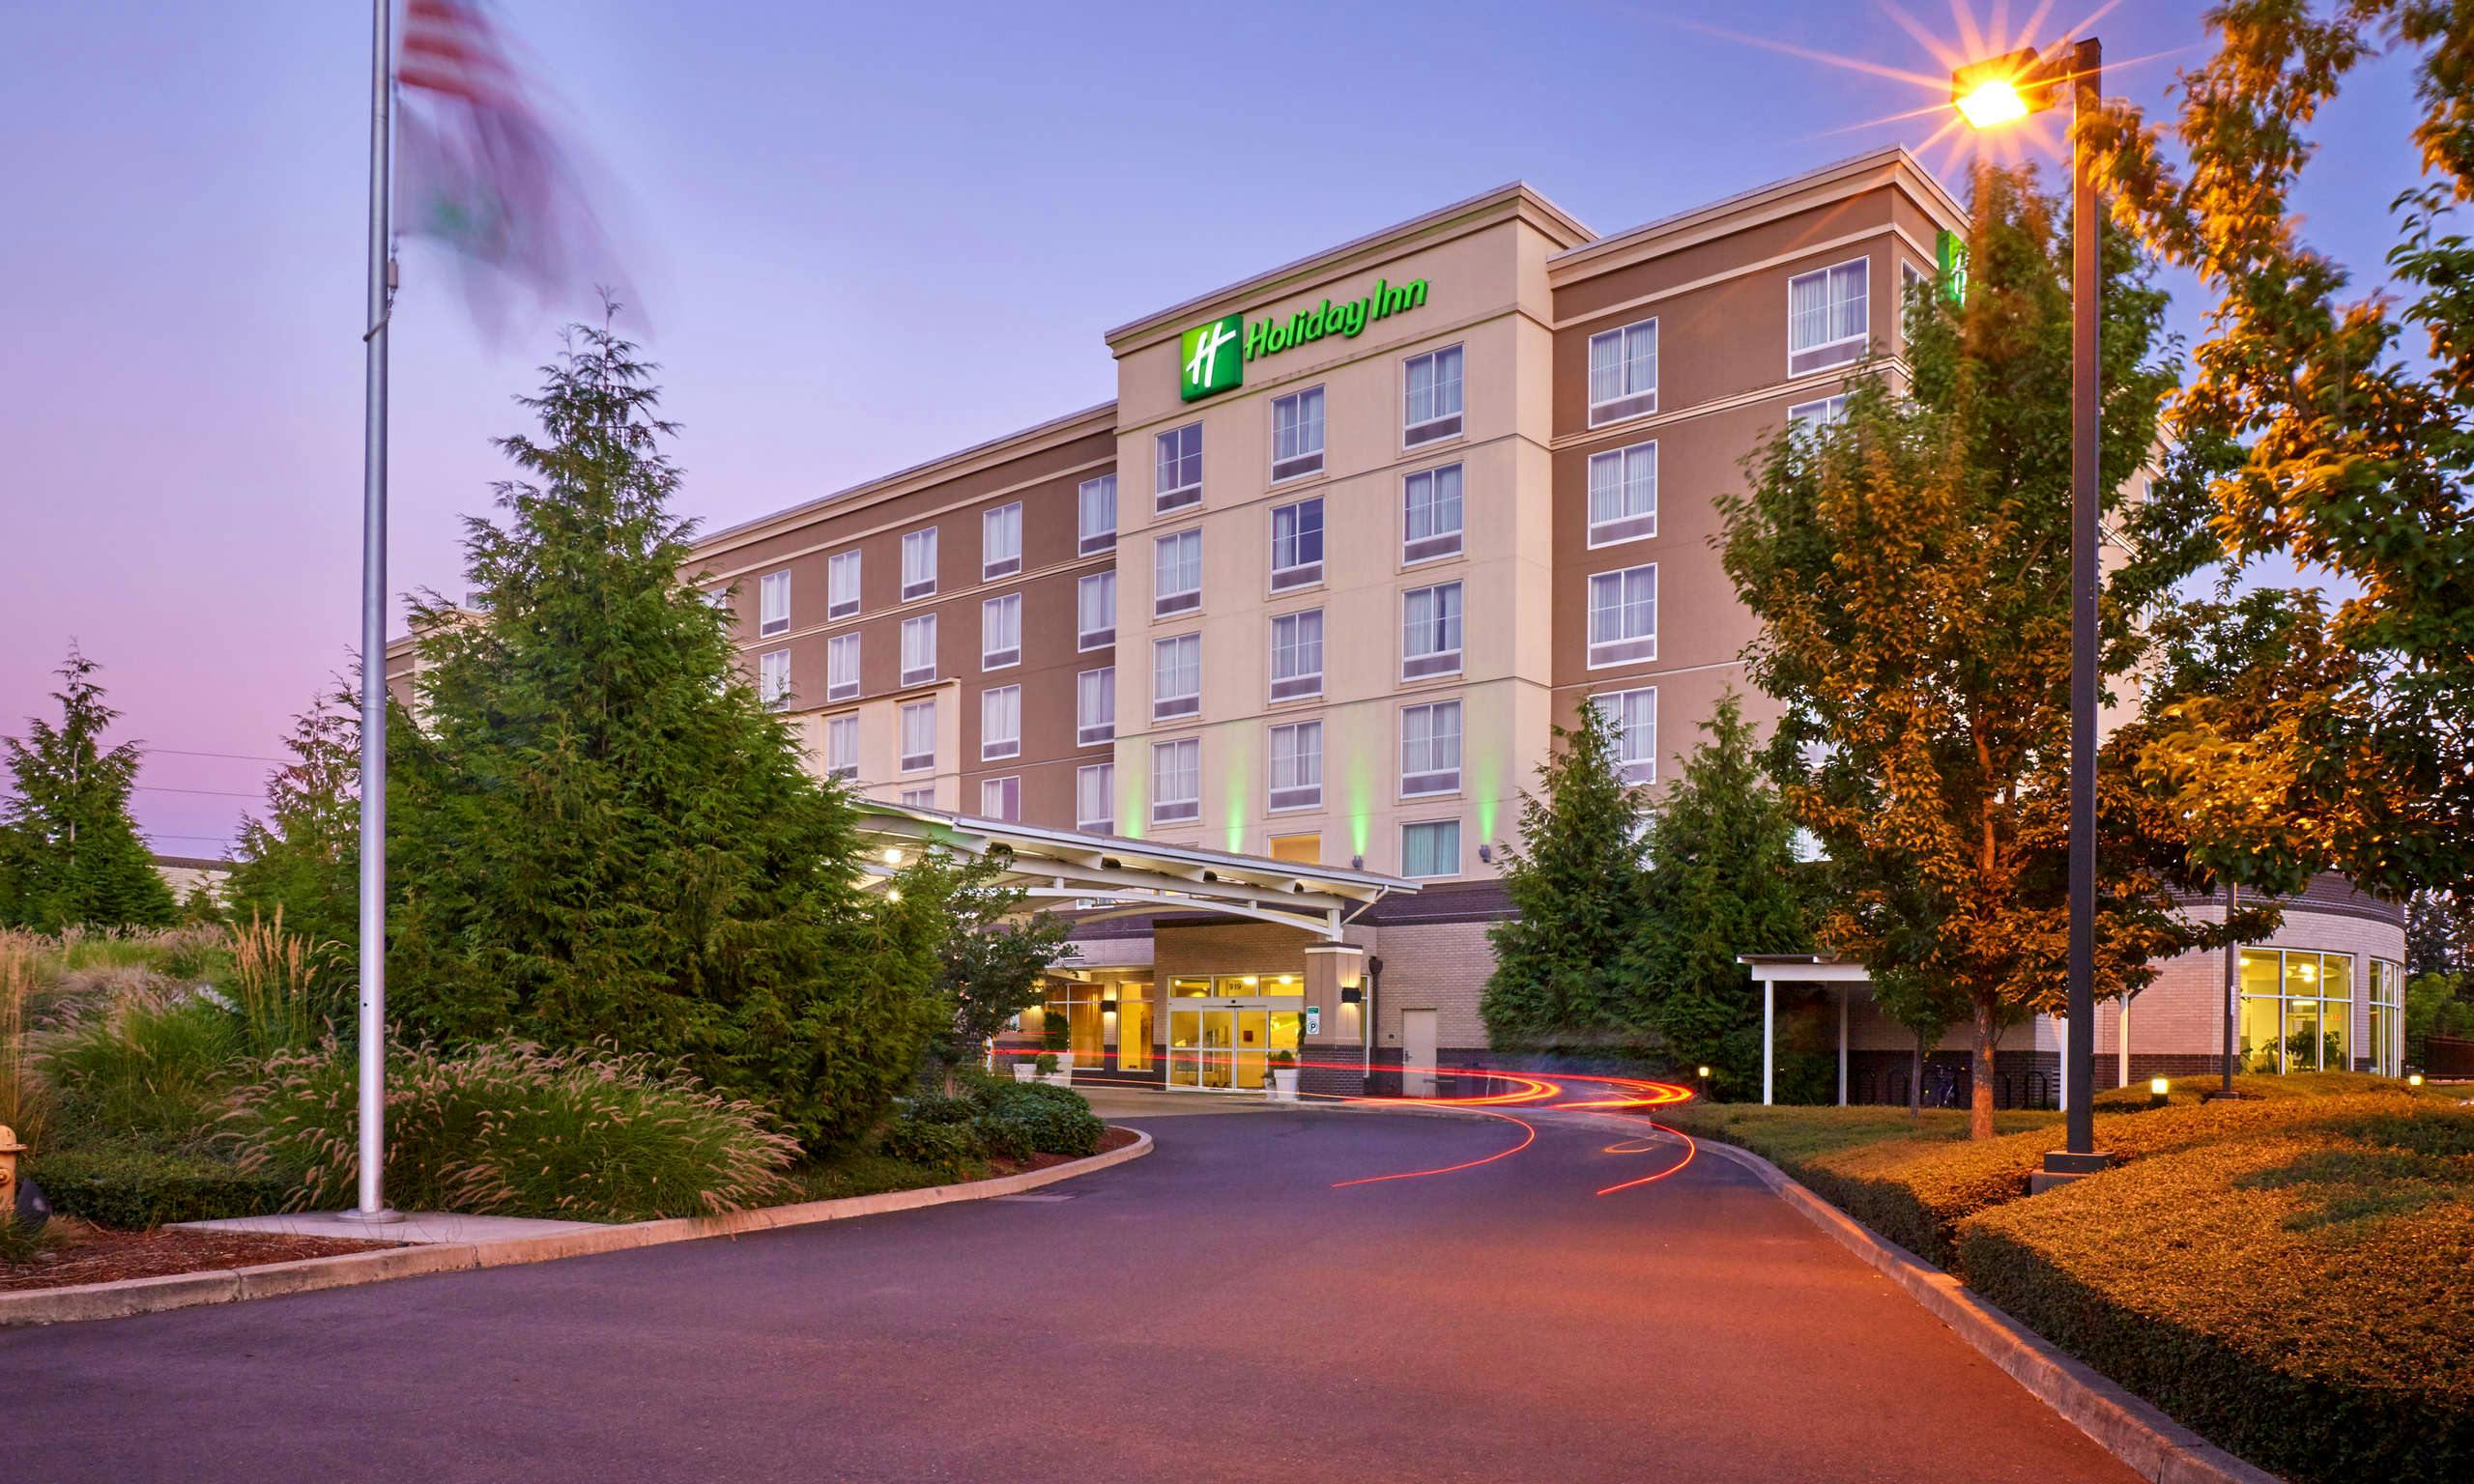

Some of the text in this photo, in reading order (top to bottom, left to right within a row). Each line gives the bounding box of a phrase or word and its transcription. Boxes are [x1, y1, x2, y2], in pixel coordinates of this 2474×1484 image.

[1186, 322, 1236, 387] H
[1245, 277, 1429, 361] Holiday Inn
